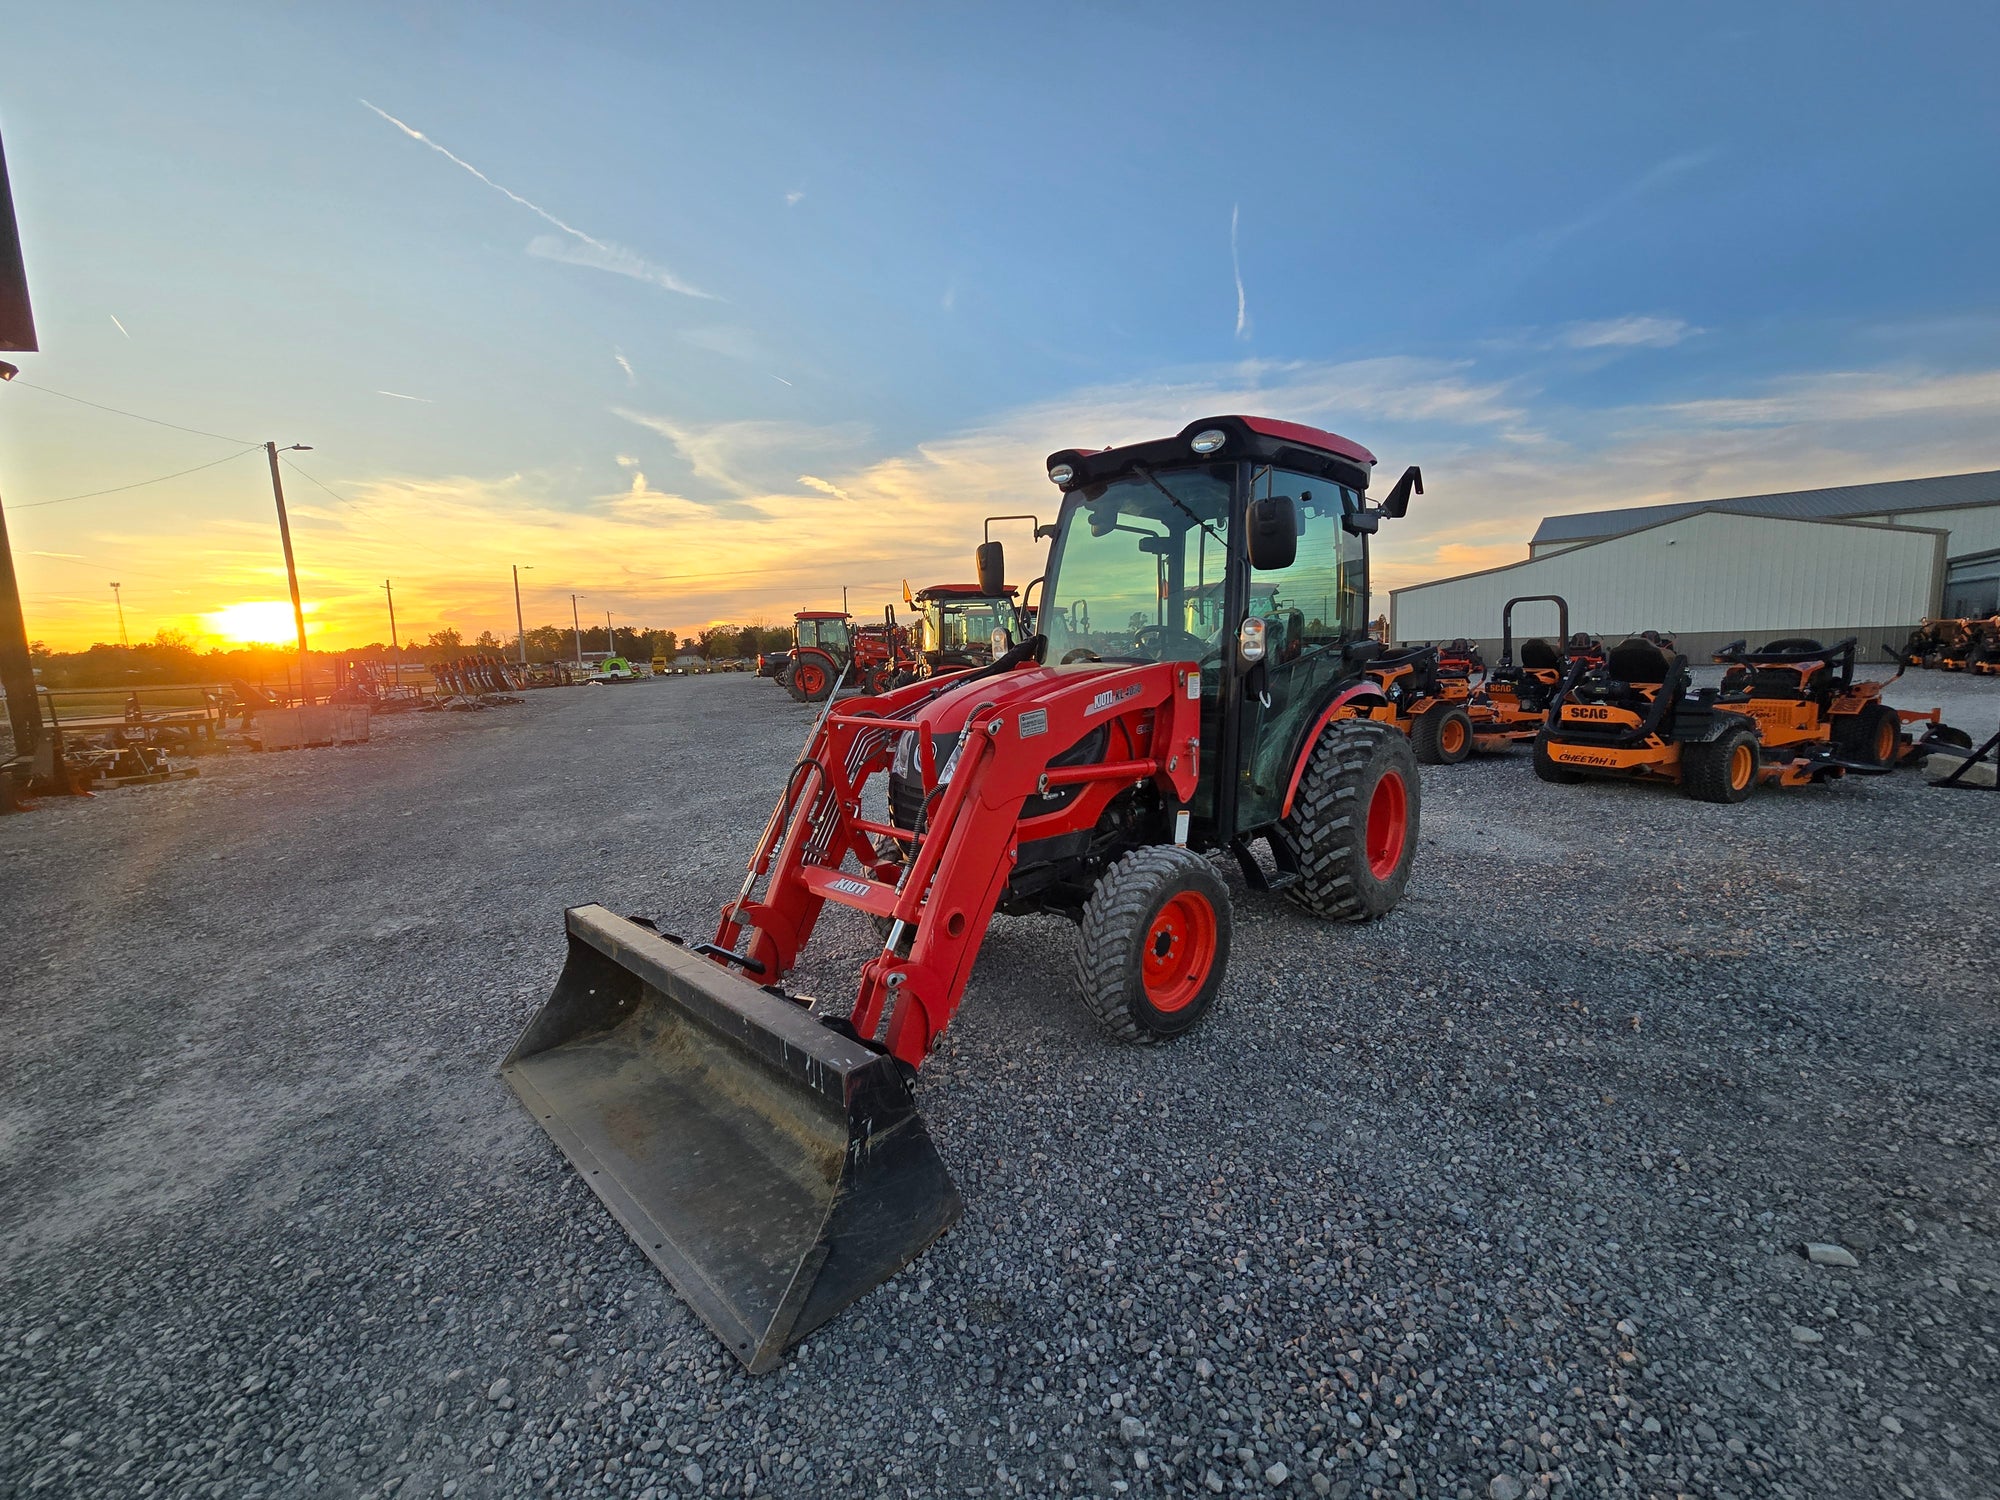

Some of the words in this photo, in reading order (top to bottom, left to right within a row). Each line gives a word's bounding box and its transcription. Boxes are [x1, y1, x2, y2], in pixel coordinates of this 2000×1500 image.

[1094, 689, 1114, 709] KIOTI
[1571, 707, 1608, 719] SCAG
[1559, 753, 1609, 766] CHEETAH
[835, 878, 871, 896] KIOTI
